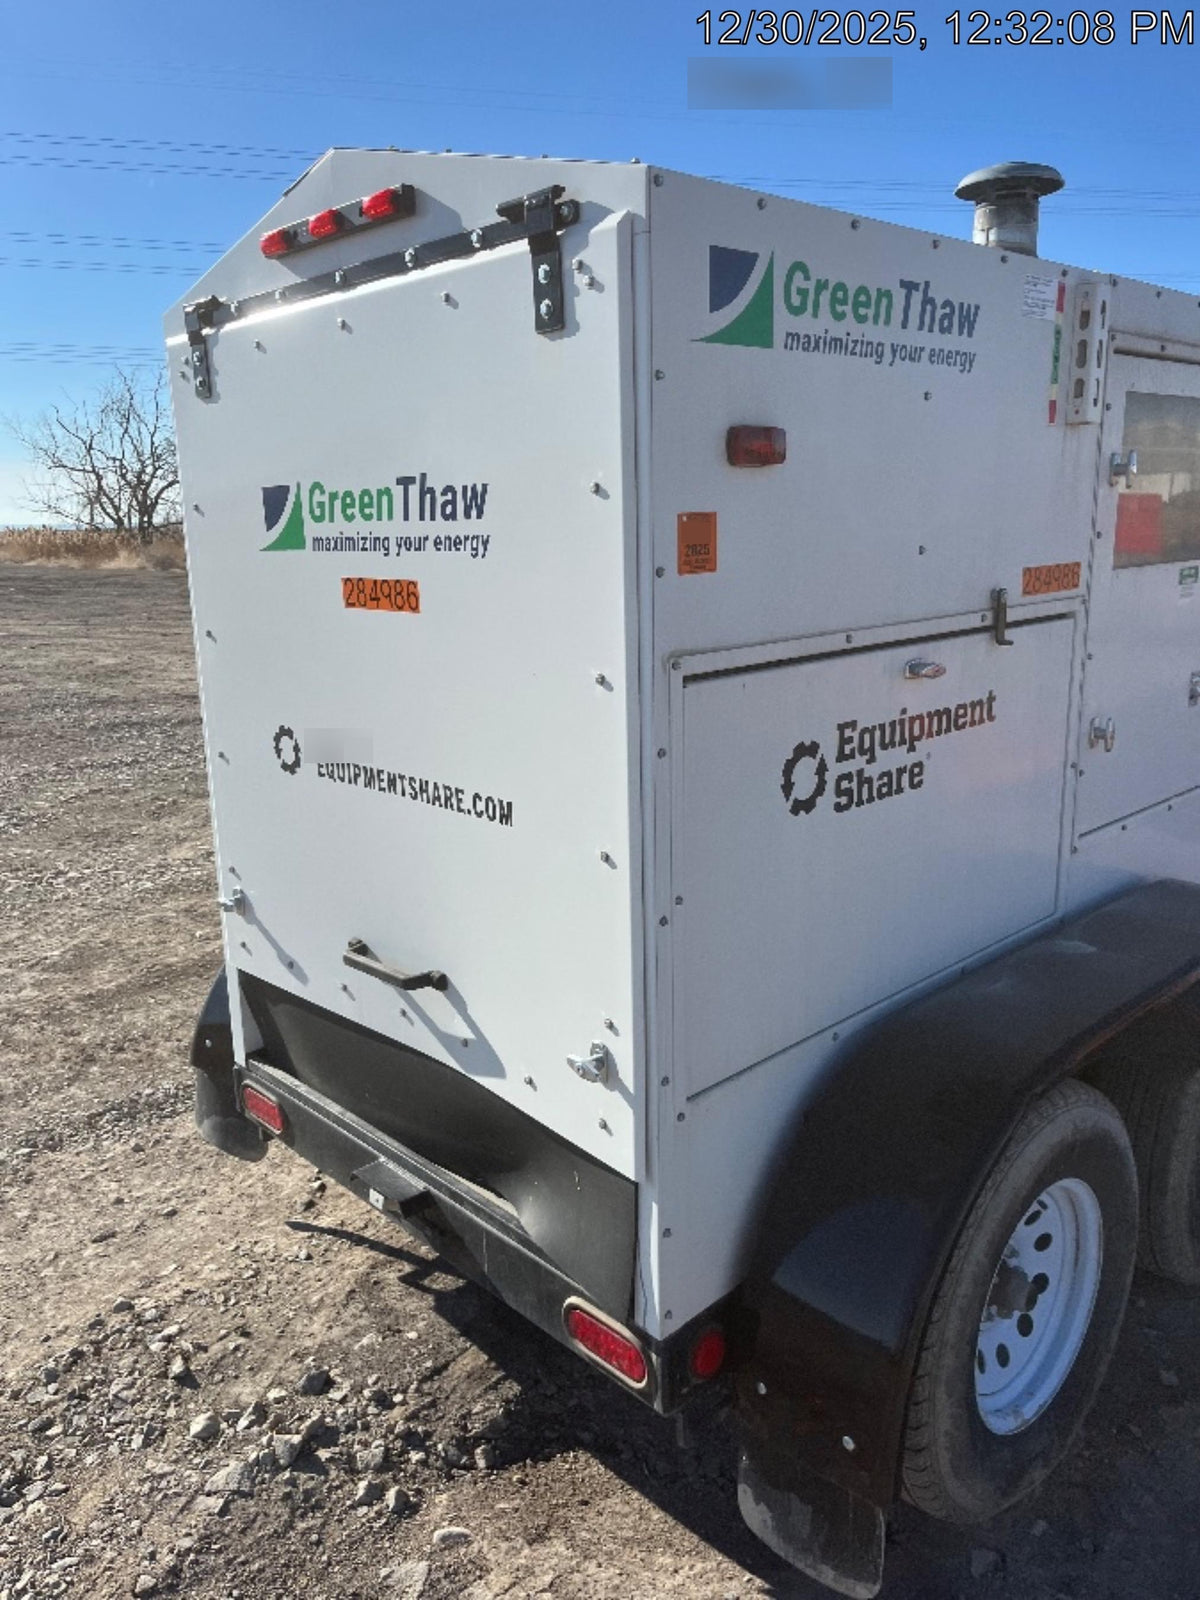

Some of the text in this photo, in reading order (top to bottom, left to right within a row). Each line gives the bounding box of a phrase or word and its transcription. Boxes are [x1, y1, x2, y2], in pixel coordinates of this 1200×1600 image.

[784, 260, 981, 338] GreenThaw
[784, 328, 977, 374] maximizing your energy
[308, 472, 490, 524] GreenThaw
[312, 531, 491, 559] maximizing your energy
[343, 577, 420, 613] 284986
[836, 689, 997, 764] Equipment
[317, 762, 513, 827] EQUIPMENTSHARE.COM
[833, 760, 925, 813] Share
